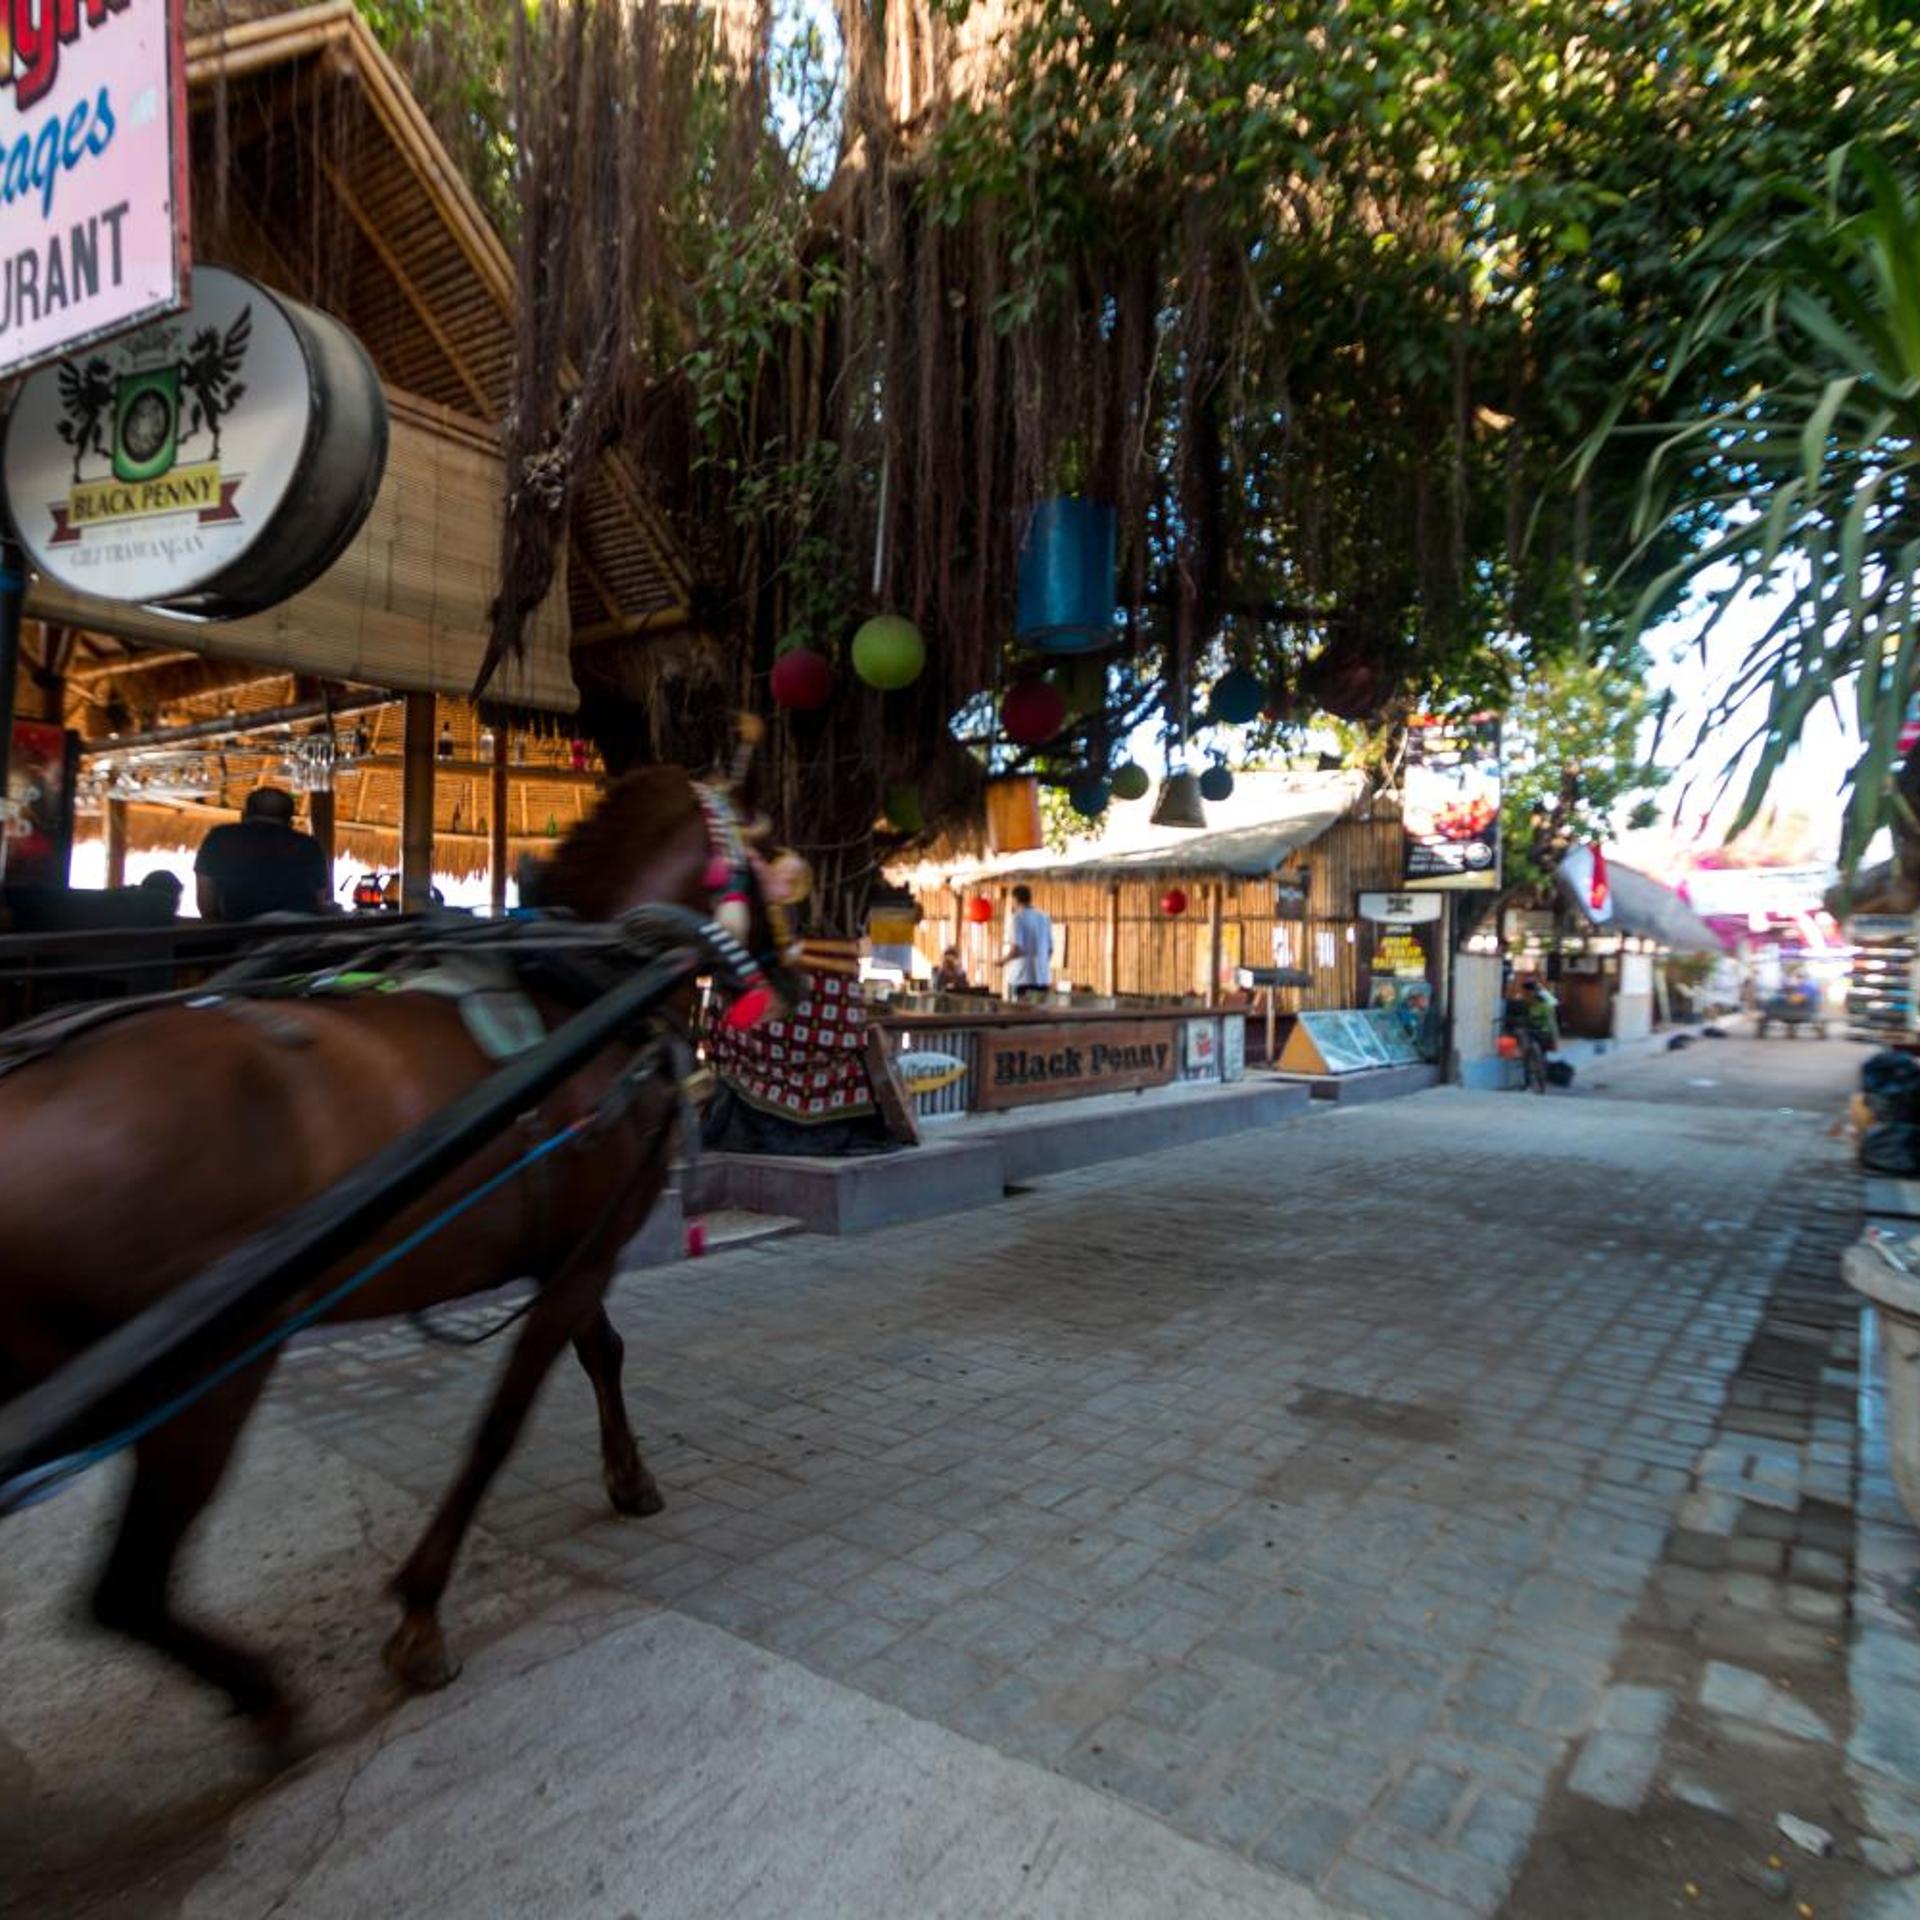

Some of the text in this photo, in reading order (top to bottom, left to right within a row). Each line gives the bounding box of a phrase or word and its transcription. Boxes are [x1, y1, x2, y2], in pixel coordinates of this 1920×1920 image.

[73, 475, 213, 520] BLACK PENNY
[994, 1047, 1082, 1085] Black
[1090, 1042, 1169, 1076] Penny
